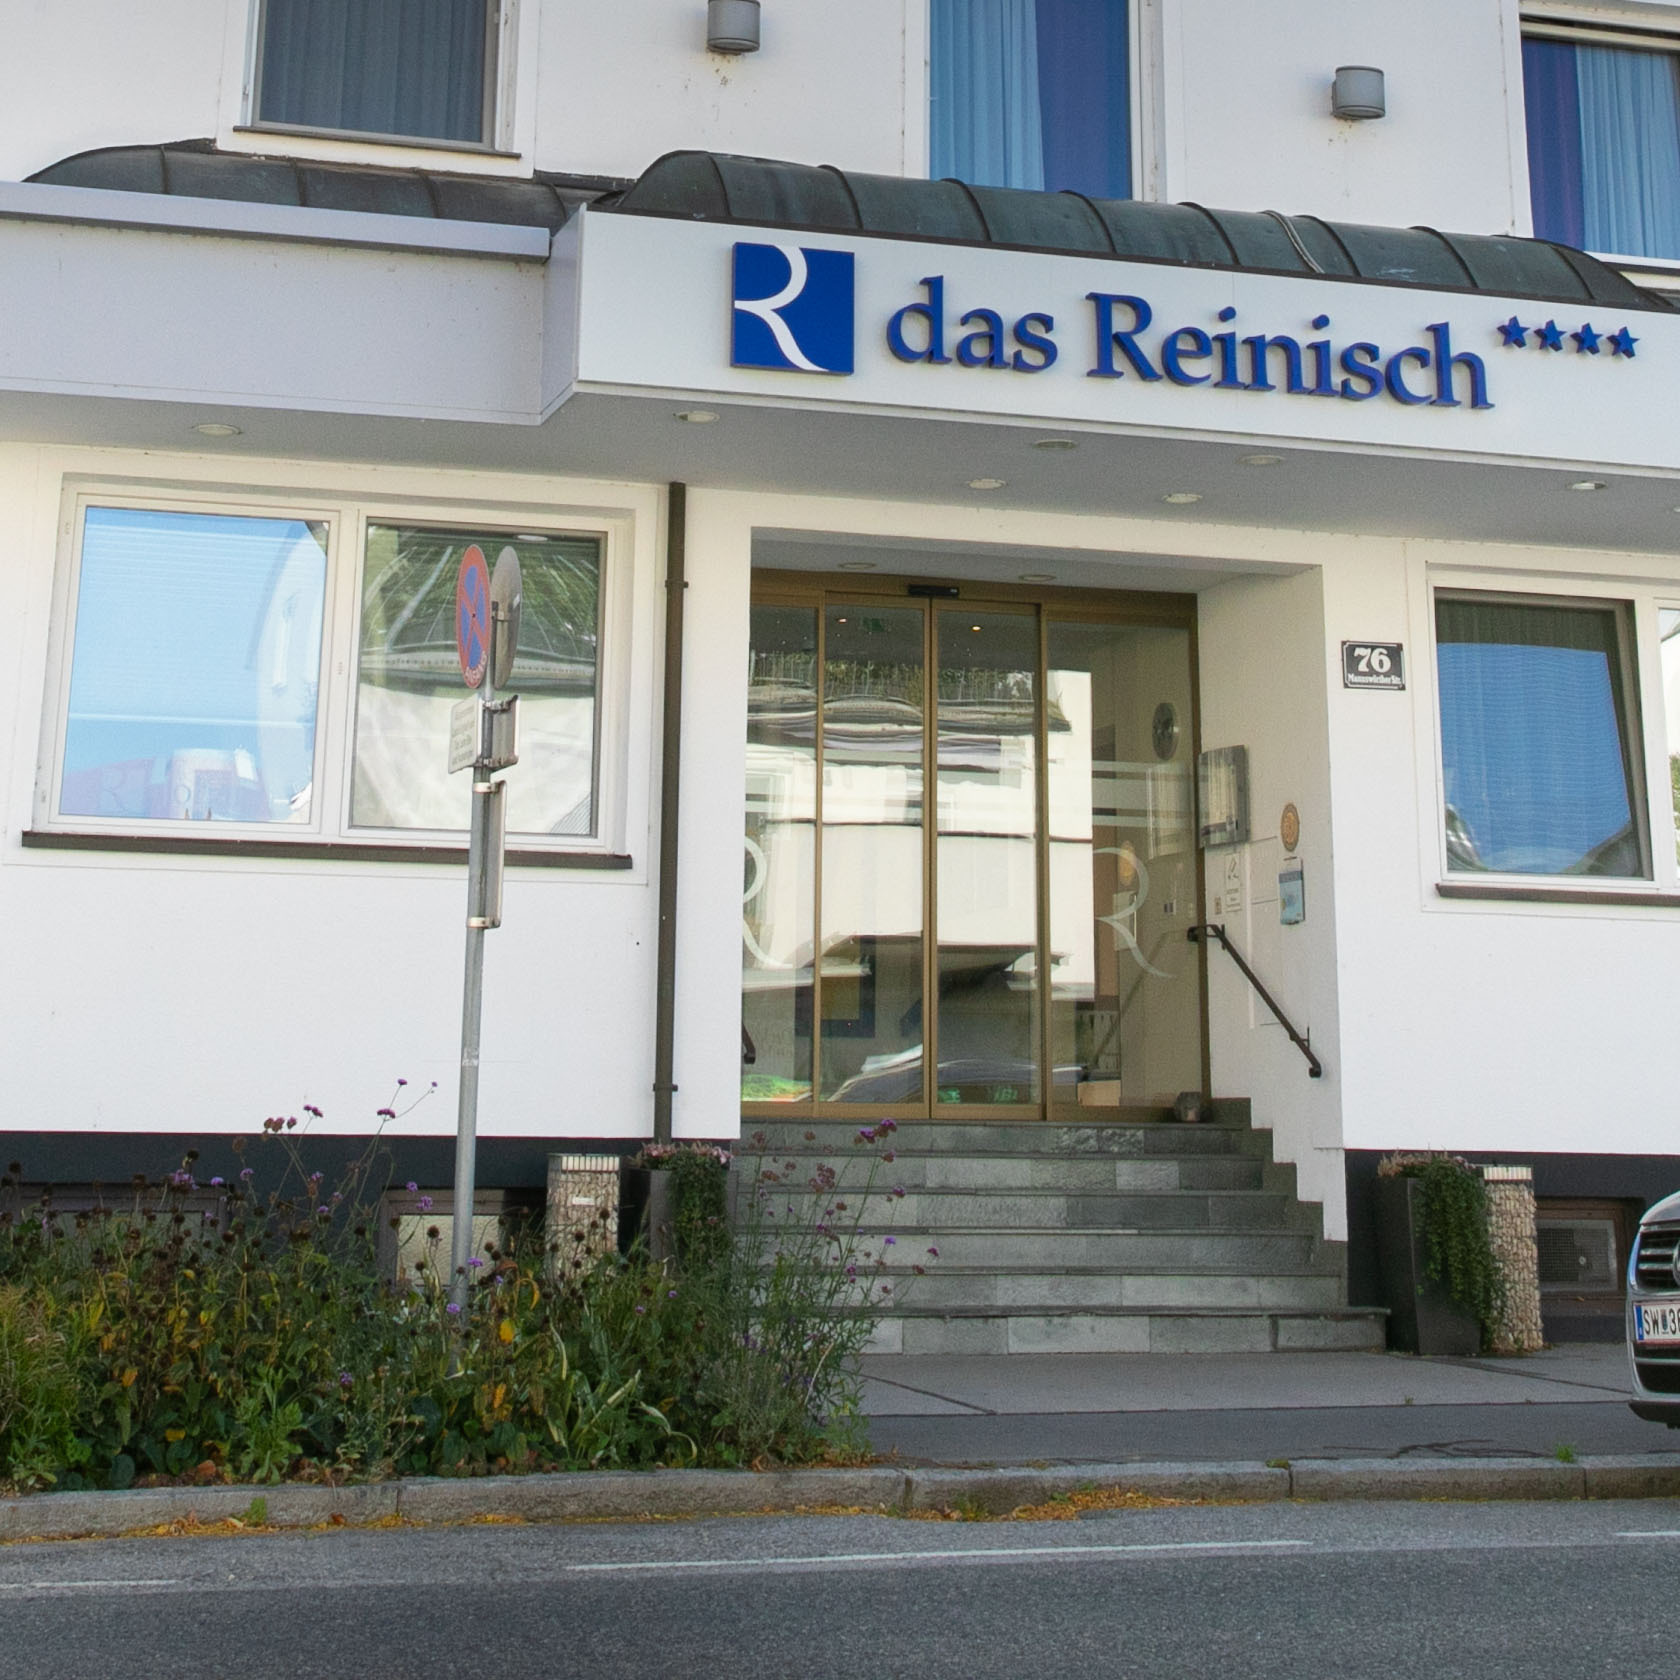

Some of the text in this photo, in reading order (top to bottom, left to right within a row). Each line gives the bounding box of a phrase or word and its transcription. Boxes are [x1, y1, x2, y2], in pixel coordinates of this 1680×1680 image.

[886, 274, 1496, 410] das Reinisch
[1353, 646, 1392, 673] 76
[1643, 1308, 1660, 1336] SW
